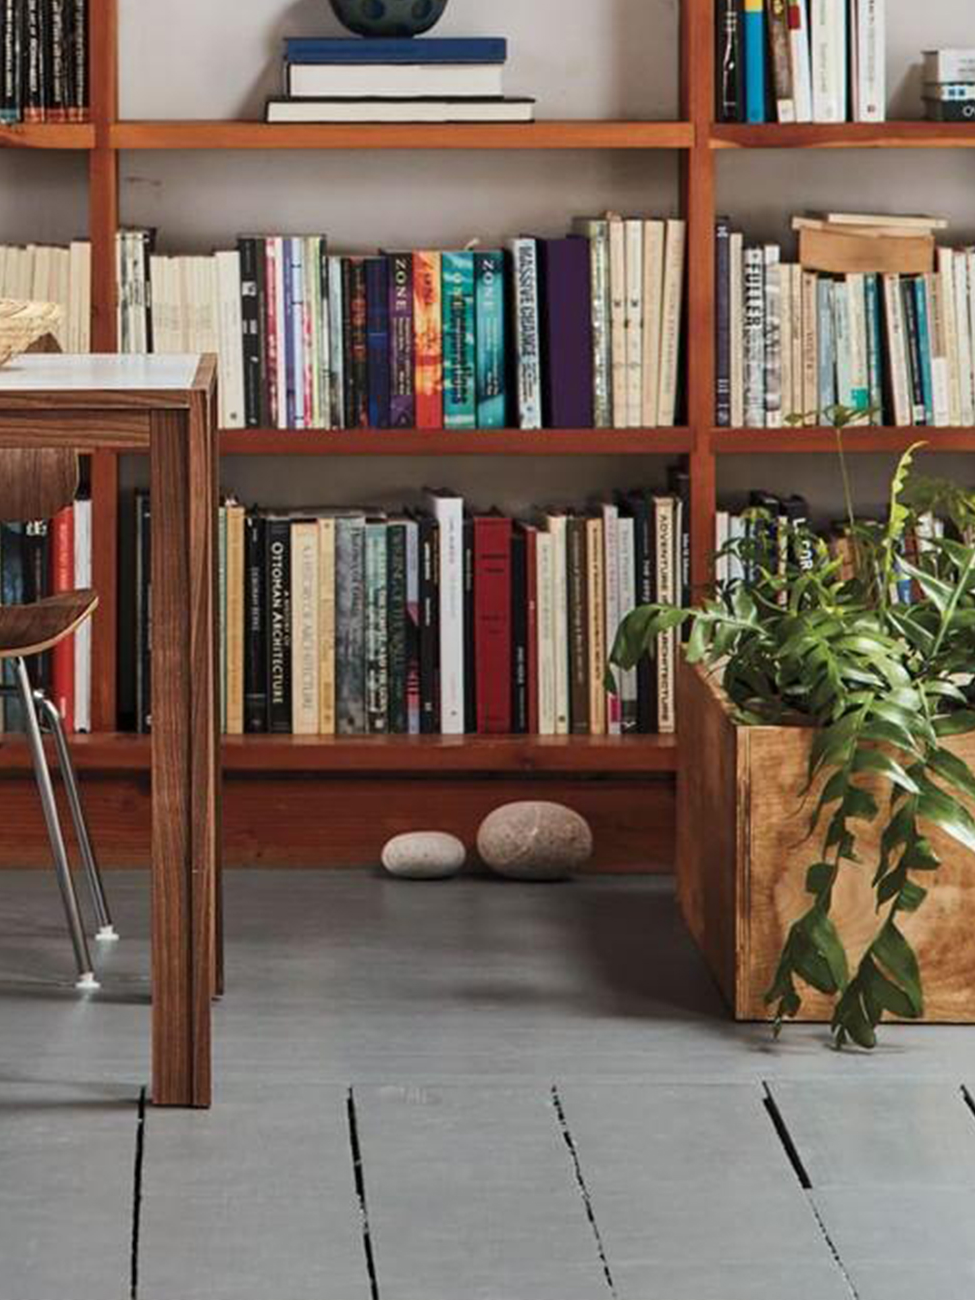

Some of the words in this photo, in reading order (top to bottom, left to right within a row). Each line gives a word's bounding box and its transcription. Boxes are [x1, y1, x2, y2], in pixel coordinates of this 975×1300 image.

[394, 258, 407, 311] ZONE
[482, 259, 495, 311] ZONE
[519, 246, 534, 303] MASSIVE
[746, 262, 762, 327] FULLER
[520, 306, 536, 357] CHANGE
[271, 541, 283, 608] OTTOMAN
[658, 514, 670, 592] ADVENTURE
[271, 611, 283, 704] ARCHITECTURE
[302, 623, 314, 710] ARCHITECTURE
